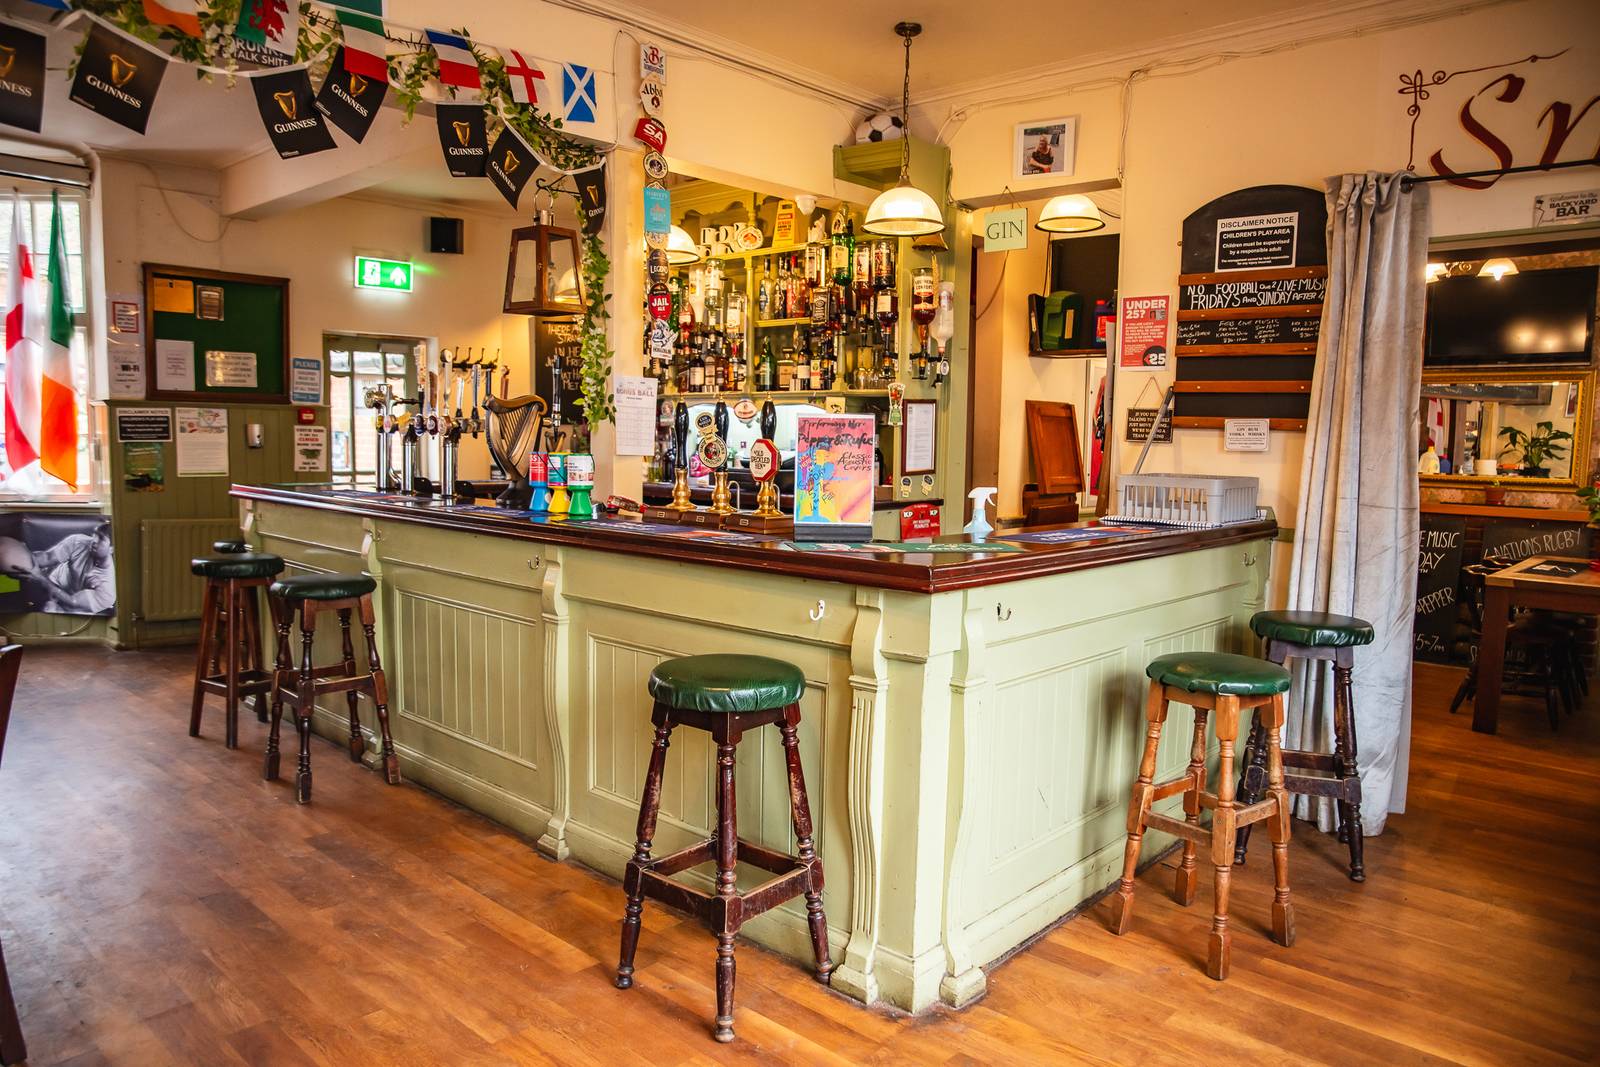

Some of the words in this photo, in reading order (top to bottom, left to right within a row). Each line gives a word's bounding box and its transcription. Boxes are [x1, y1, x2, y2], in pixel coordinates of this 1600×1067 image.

[0, 80, 32, 98] NESS
[85, 74, 142, 109] GUINNESS
[330, 83, 369, 118] GUINNESS
[274, 117, 318, 134] GUINNESS
[643, 123, 664, 145] SA
[448, 146, 484, 156] GUINNESS
[491, 160, 517, 192] GUINNESS
[1549, 198, 1598, 209] BACKYARD
[1556, 205, 1590, 218] BAR
[986, 219, 1024, 240] GIN
[1220, 219, 1265, 229] DISCLAIMER
[1266, 216, 1295, 225] NOTICE
[1222, 231, 1257, 240] CHILDREN'S
[1263, 238, 1291, 246] supervised
[1240, 247, 1269, 255] responsible
[1187, 284, 1205, 296] NO
[1215, 281, 1259, 295] FOOTBALL
[1276, 279, 1299, 292] LIVE
[651, 297, 669, 307] JAIL
[1126, 299, 1167, 310] UNDER
[1190, 293, 1241, 310] FRIDAYS
[1256, 291, 1293, 306] SUNDAY
[1125, 309, 1146, 319] 25?
[1149, 353, 1166, 365] 25
[637, 389, 655, 397] BALL
[1426, 530, 1460, 549] MUSIC
[1542, 527, 1581, 553] RUGBY
[1419, 586, 1455, 615] PEPPER
